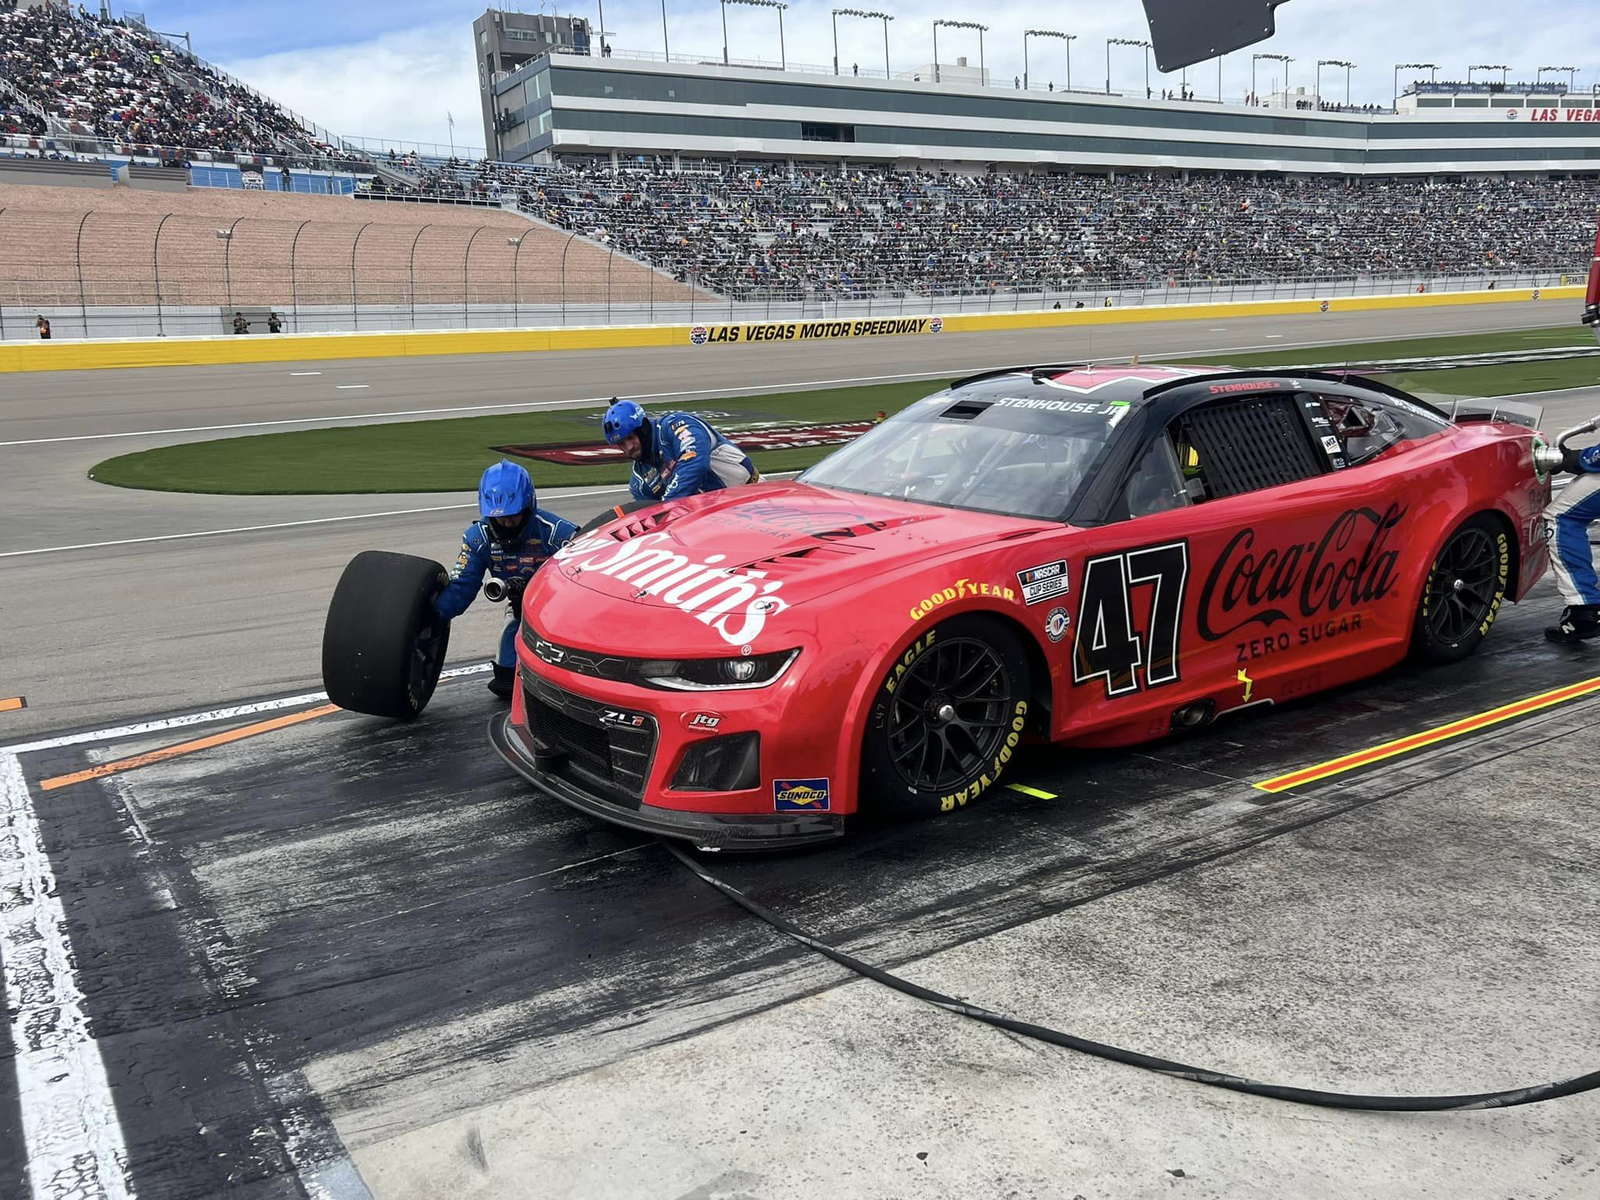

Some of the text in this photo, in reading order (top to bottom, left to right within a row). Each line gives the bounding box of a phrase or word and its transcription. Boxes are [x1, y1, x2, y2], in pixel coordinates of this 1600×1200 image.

[1531, 108, 1558, 121] LAS
[708, 318, 928, 342] LAS VEGAS MOTOR SPEEDWAY
[1209, 381, 1273, 394] STENHOUSE
[994, 397, 1098, 414] STENHOUSE
[578, 531, 791, 645] Smith's
[1029, 578, 1063, 597] CUP SERIES
[1034, 564, 1061, 581] NASCAR
[1197, 502, 1410, 642] Coca-Cola
[910, 579, 1015, 621] GOODYEAR
[1073, 541, 1189, 697] 47
[1236, 613, 1362, 663] ZERO SUGAR
[885, 629, 936, 695] EAGLE
[940, 700, 1028, 812] GOODYEAR
[779, 790, 826, 800] SUNOCO
